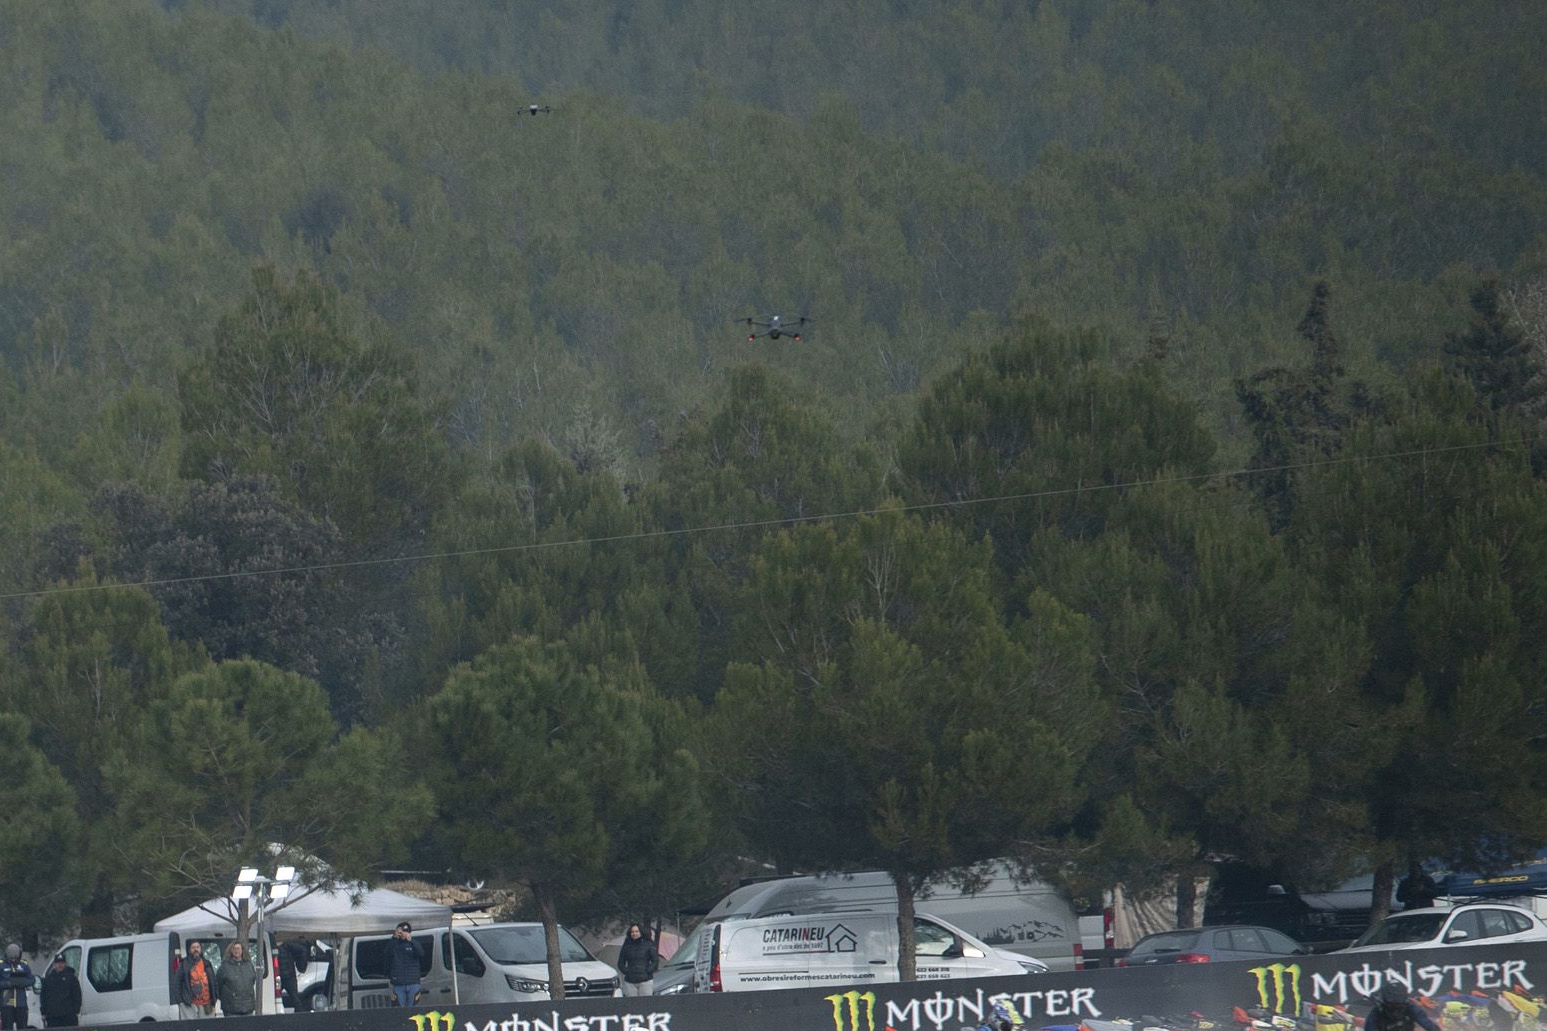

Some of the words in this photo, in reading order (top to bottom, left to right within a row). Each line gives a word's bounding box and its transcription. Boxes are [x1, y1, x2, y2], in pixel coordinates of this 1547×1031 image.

[763, 927, 825, 944] CATARINEU
[740, 973, 876, 984] www.obresireformescatarineu.com
[1311, 960, 1535, 1004] MONSTER
[885, 988, 1102, 1031] MONTER
